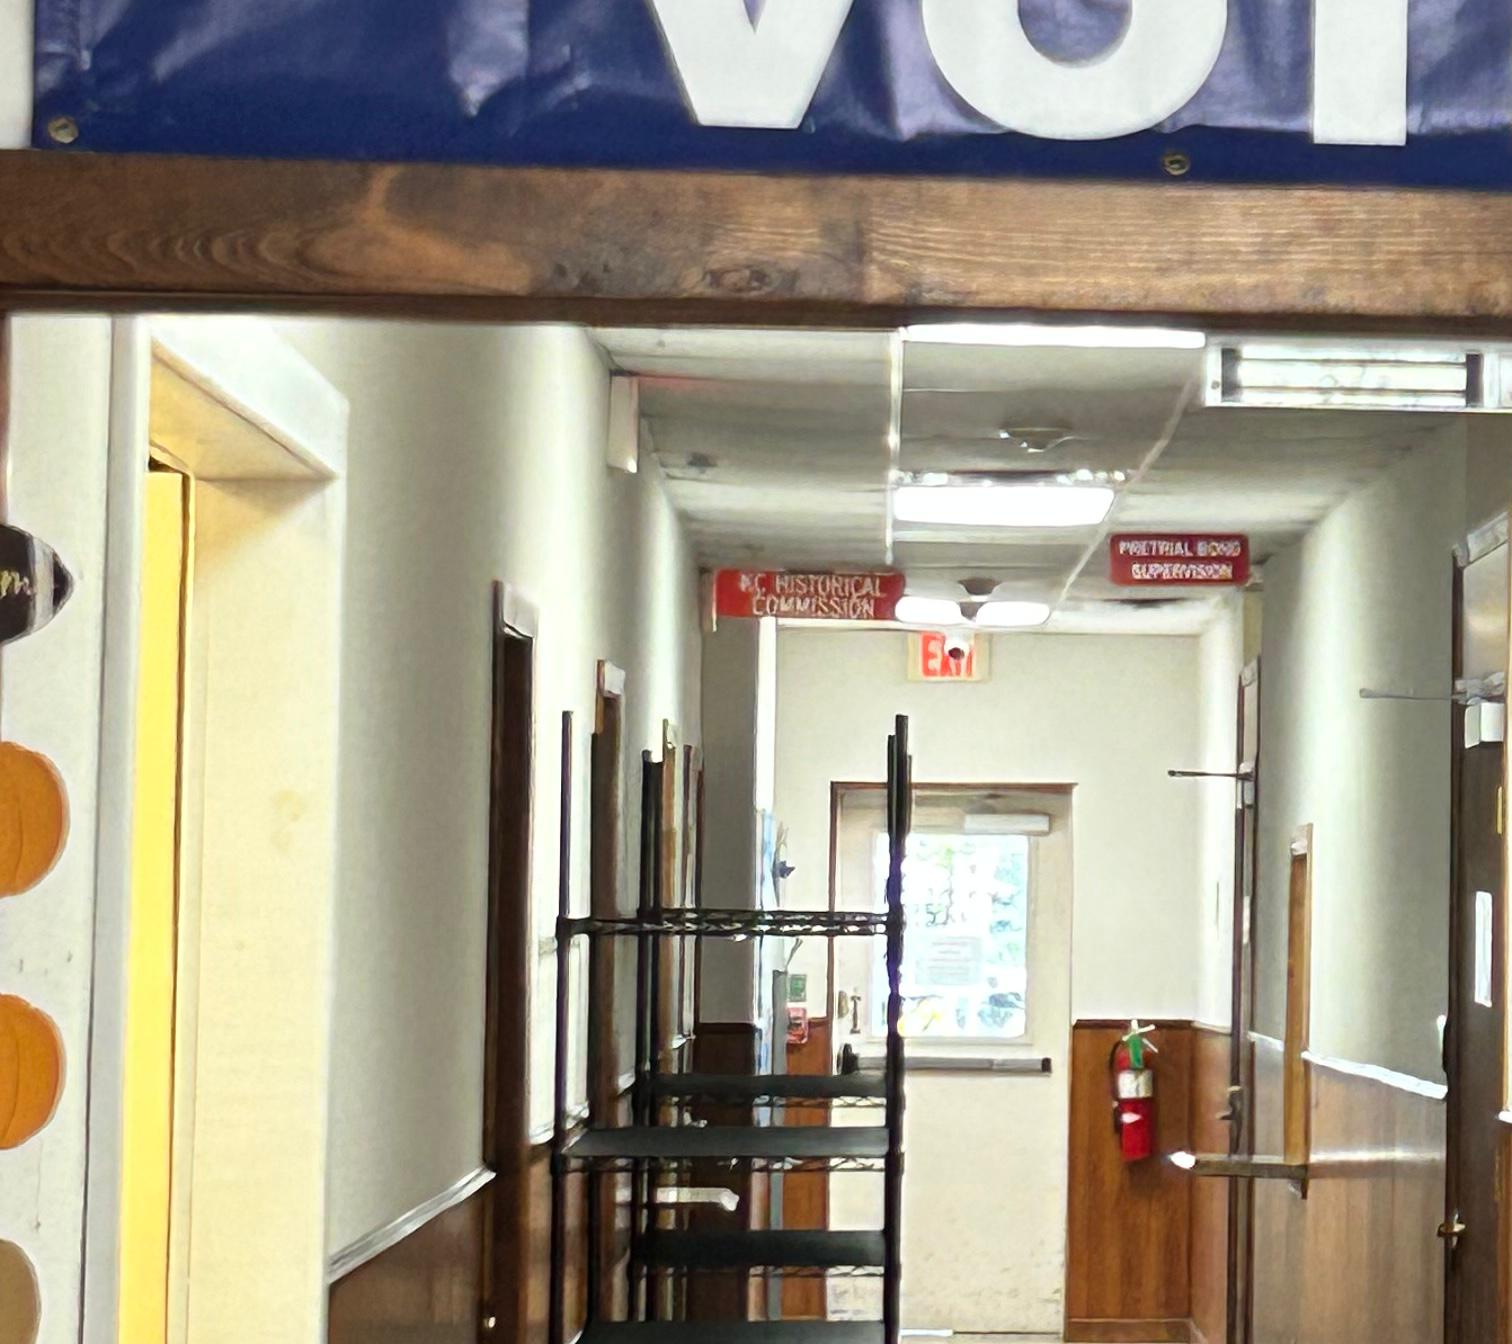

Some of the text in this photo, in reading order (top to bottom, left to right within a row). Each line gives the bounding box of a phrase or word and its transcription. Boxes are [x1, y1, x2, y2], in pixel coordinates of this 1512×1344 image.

[1119, 539, 1194, 557] PRETRIAL
[775, 574, 885, 599] HISTORICAL
[753, 592, 875, 618] COMMISSION
